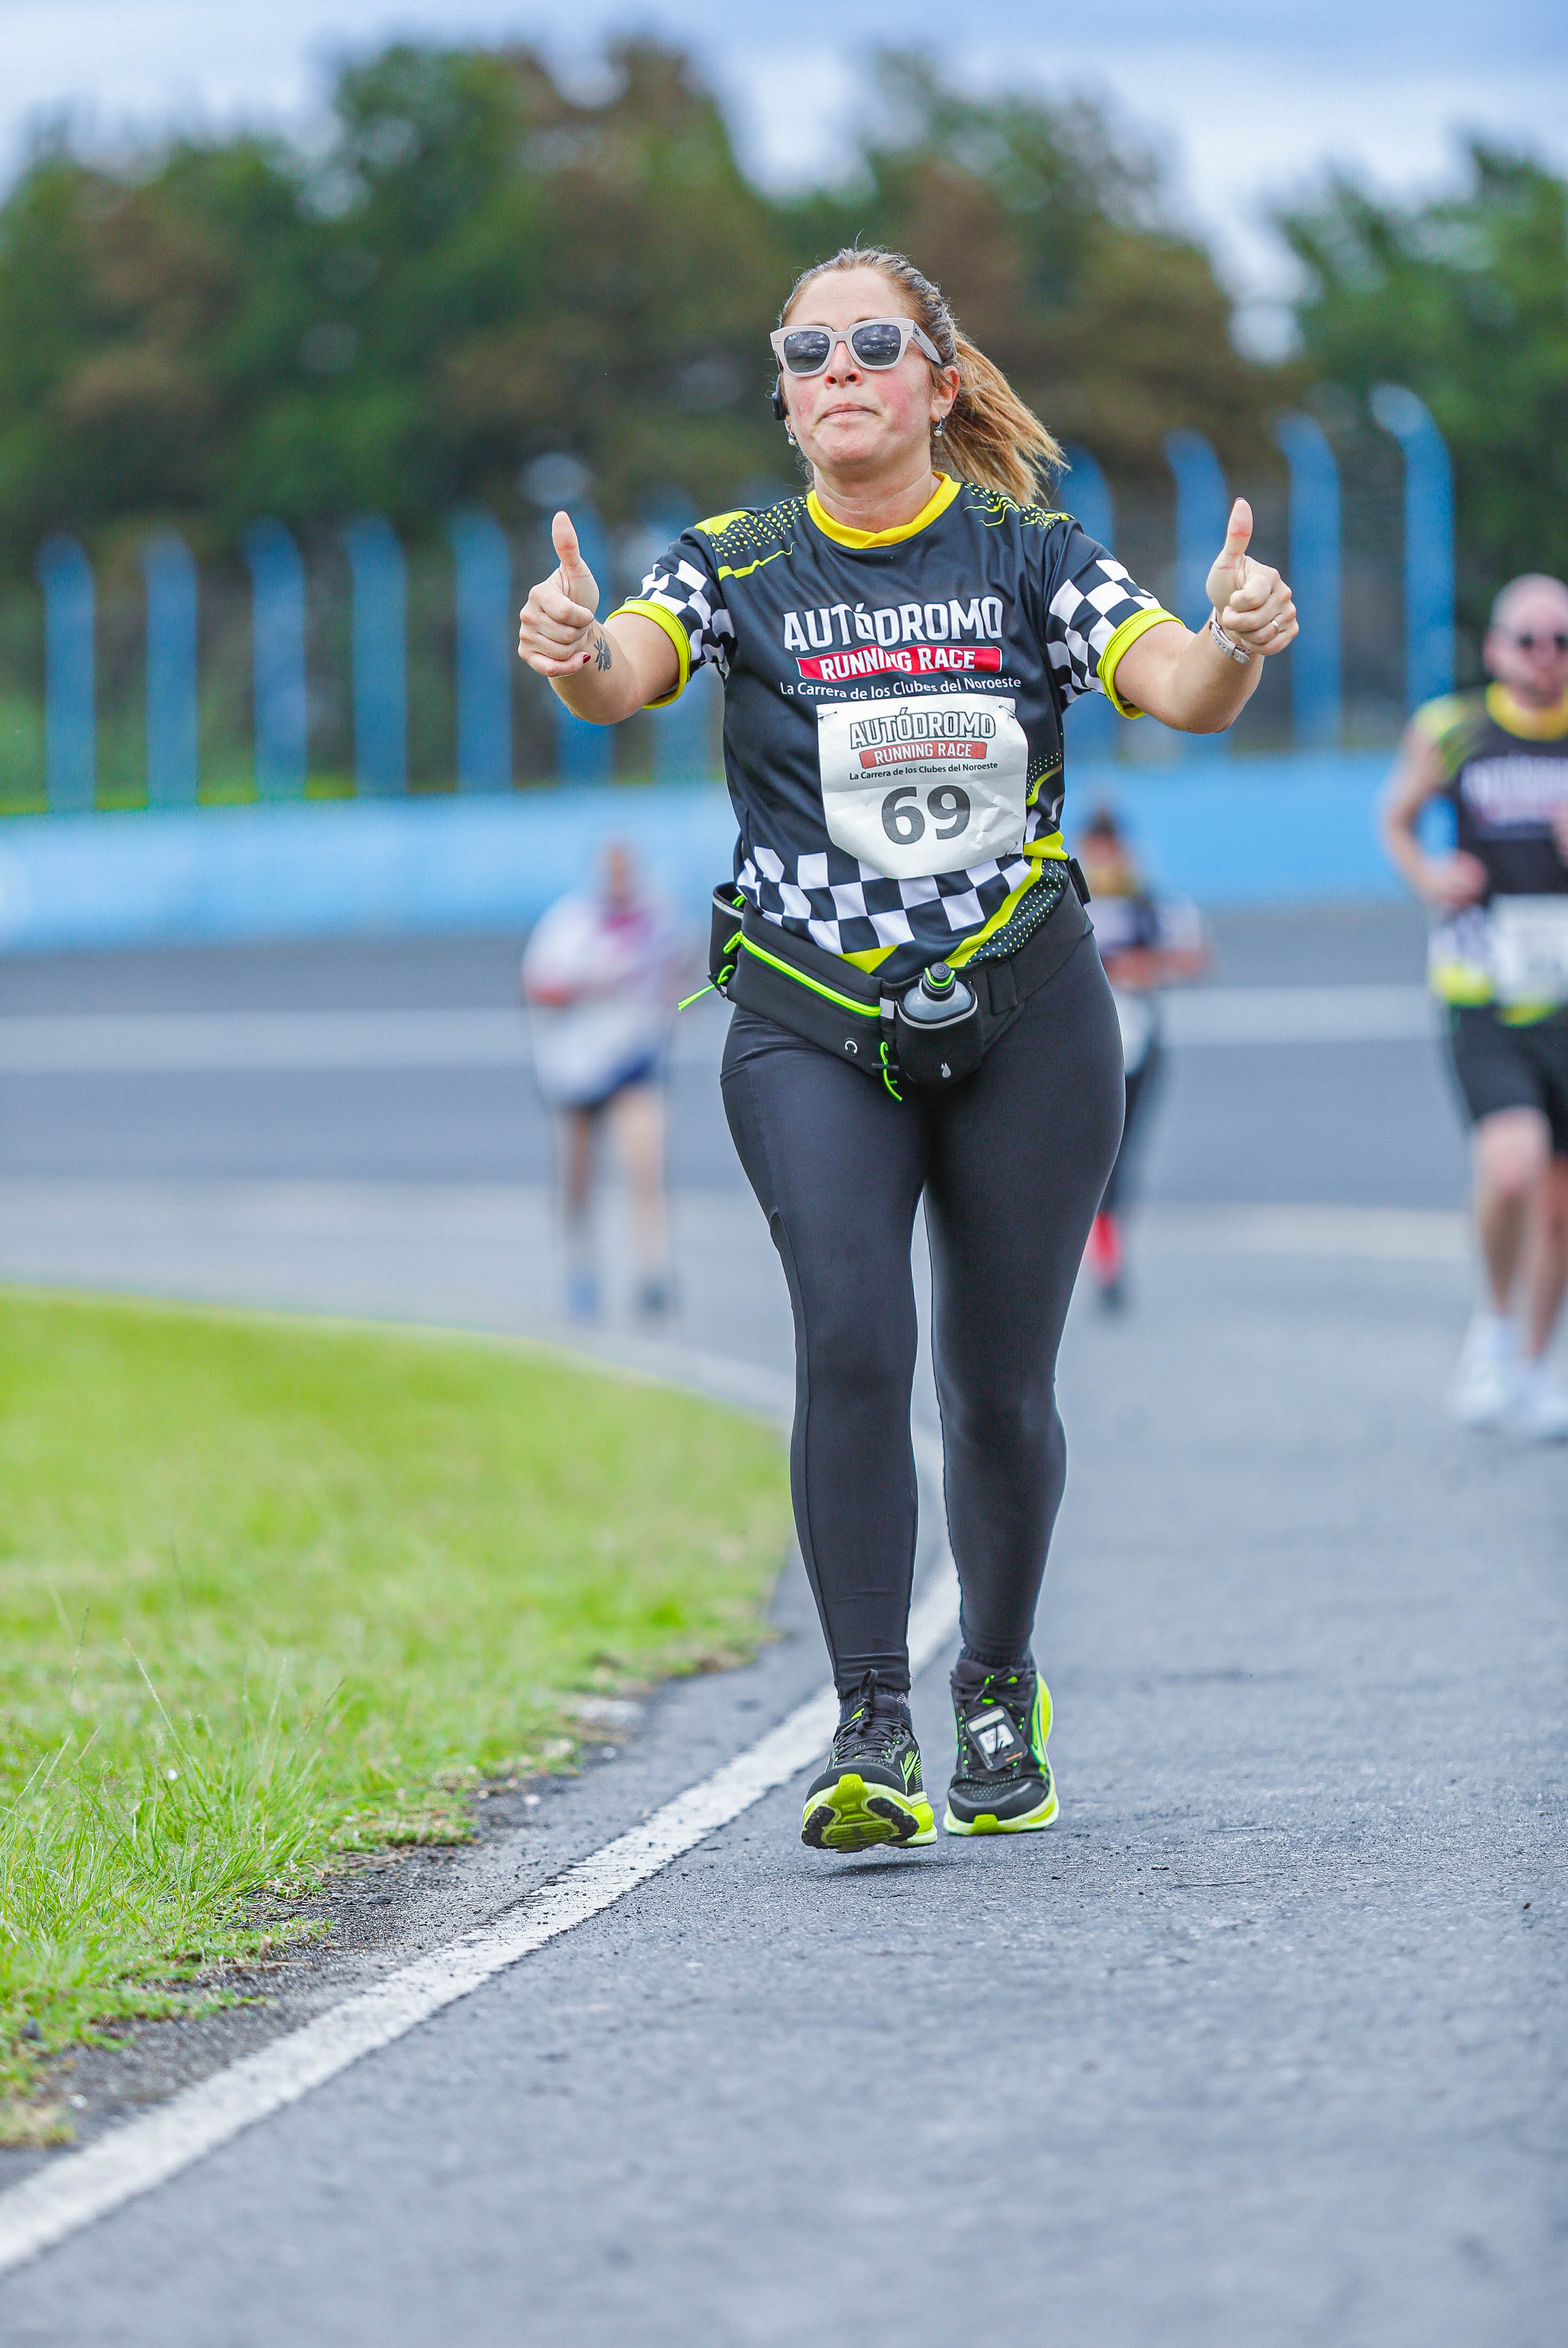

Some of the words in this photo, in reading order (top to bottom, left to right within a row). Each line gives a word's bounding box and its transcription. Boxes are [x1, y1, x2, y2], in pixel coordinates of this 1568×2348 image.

[783, 596, 1003, 652] AUTÓDROMO
[818, 647, 912, 680] RUNNING
[917, 647, 976, 671] RACE
[780, 682, 794, 695] La
[797, 682, 847, 698] Carrera
[850, 687, 868, 700] de
[871, 685, 891, 698] los
[893, 680, 938, 695] Clubes
[940, 678, 962, 693] del
[963, 677, 1021, 690] Noroeste
[850, 706, 996, 750] AUTÓDROMO
[849, 772, 859, 781] La
[860, 769, 891, 779] Carrera
[919, 765, 946, 774] Clubes
[948, 763, 961, 772] del
[963, 761, 998, 771] Noroeste
[873, 743, 933, 766] RUNNING
[937, 743, 973, 758] RACE
[881, 784, 971, 845] 69
